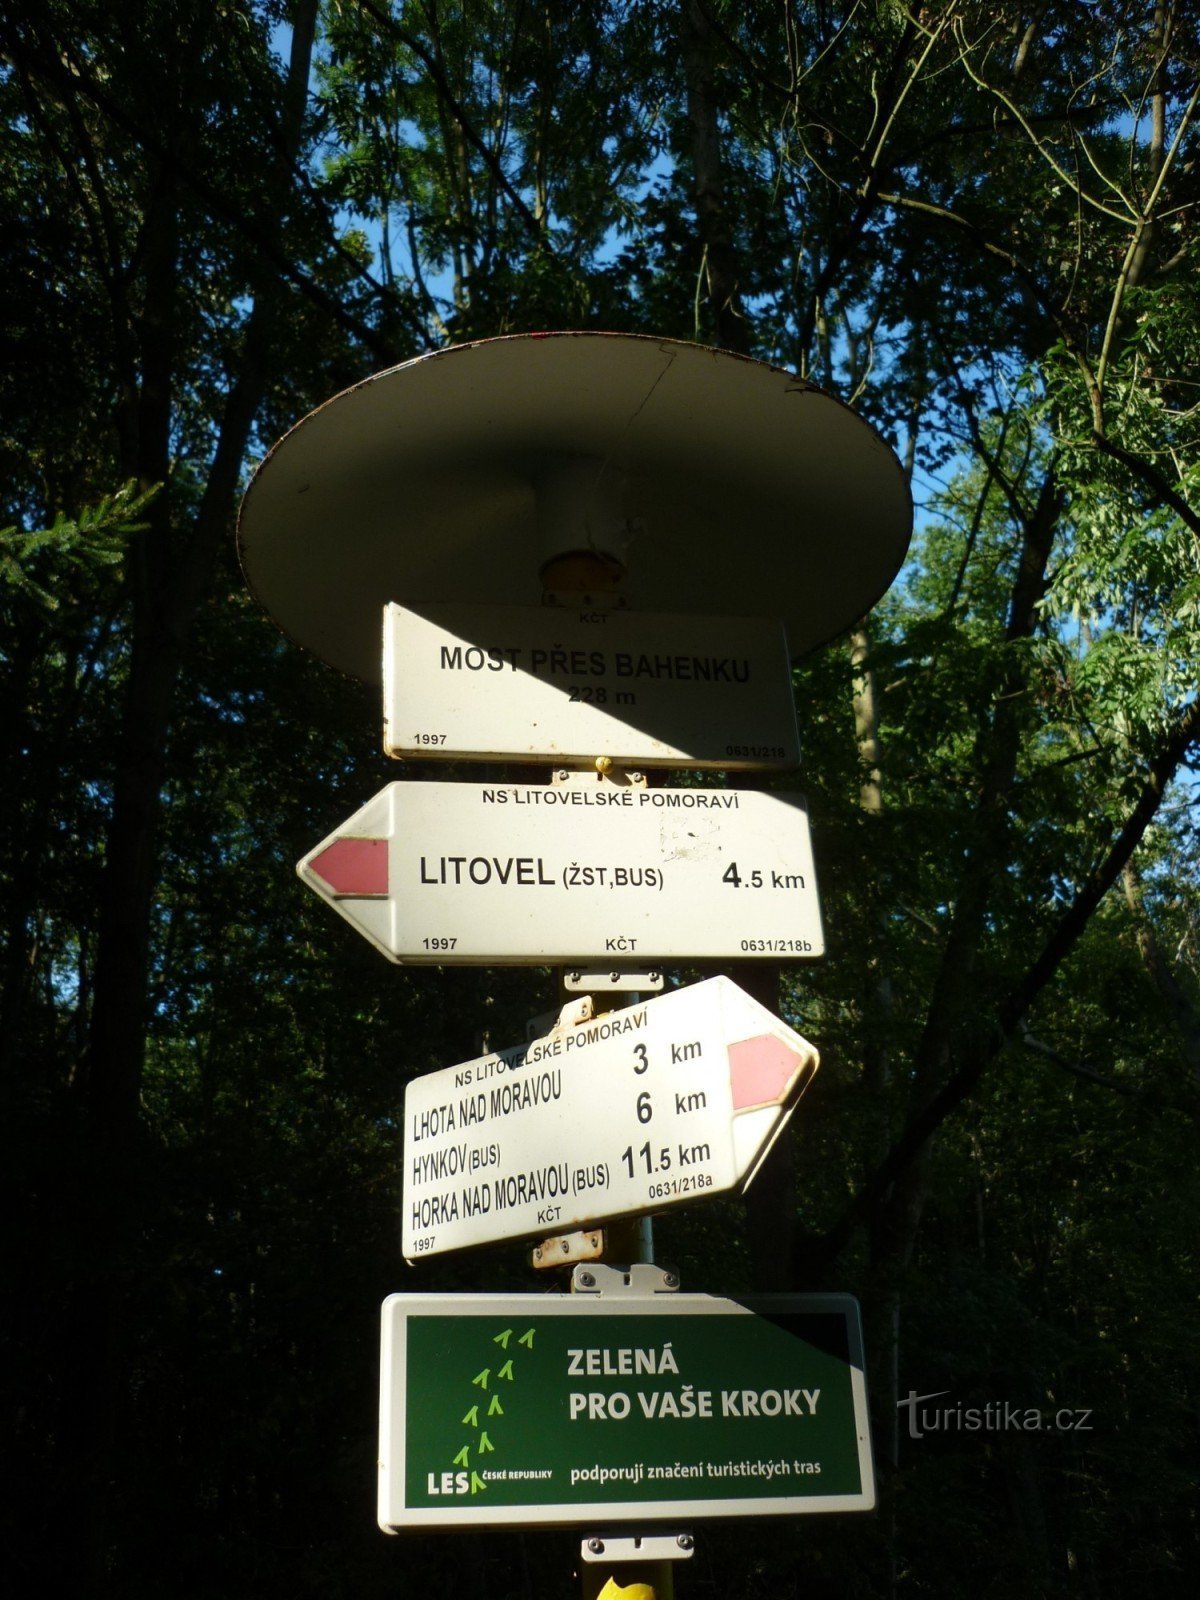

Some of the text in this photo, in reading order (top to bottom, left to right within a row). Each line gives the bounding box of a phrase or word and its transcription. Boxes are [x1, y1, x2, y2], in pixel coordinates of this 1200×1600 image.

[580, 611, 609, 625] KČT
[441, 643, 750, 684] MOST PŘES BAHENKU
[569, 687, 636, 705] 228 m
[414, 734, 447, 746] 1997
[726, 745, 786, 759] 0631/218
[482, 790, 739, 810] NS LITOVELSKÉ POMORAVÍ
[420, 857, 805, 892] LITOVEL (ŽST,BUS) 4.5 km
[423, 938, 458, 951] 1997
[606, 936, 637, 951] KČT
[741, 939, 812, 953] 0631/218b
[455, 1006, 649, 1088] NS LITOVELSKÉ POMORAVÍ
[413, 1039, 702, 1142] LHOTA NAD MORAVOU 3 km
[637, 1092, 653, 1124] 6
[676, 1089, 707, 1115] km
[412, 1140, 711, 1231] HORKA NAD MORAVOU (BUS) 11.5 km
[648, 1175, 713, 1200] 0631/218a
[537, 1206, 561, 1225] KČT
[413, 1237, 436, 1252] 1997
[567, 1342, 679, 1376] ZELENÁ
[570, 1385, 821, 1420] PRO VAŠE KROKY
[482, 1469, 552, 1480] ČESKÉ REPUBLIKY
[571, 1459, 821, 1485] podporují značení turistických tras
